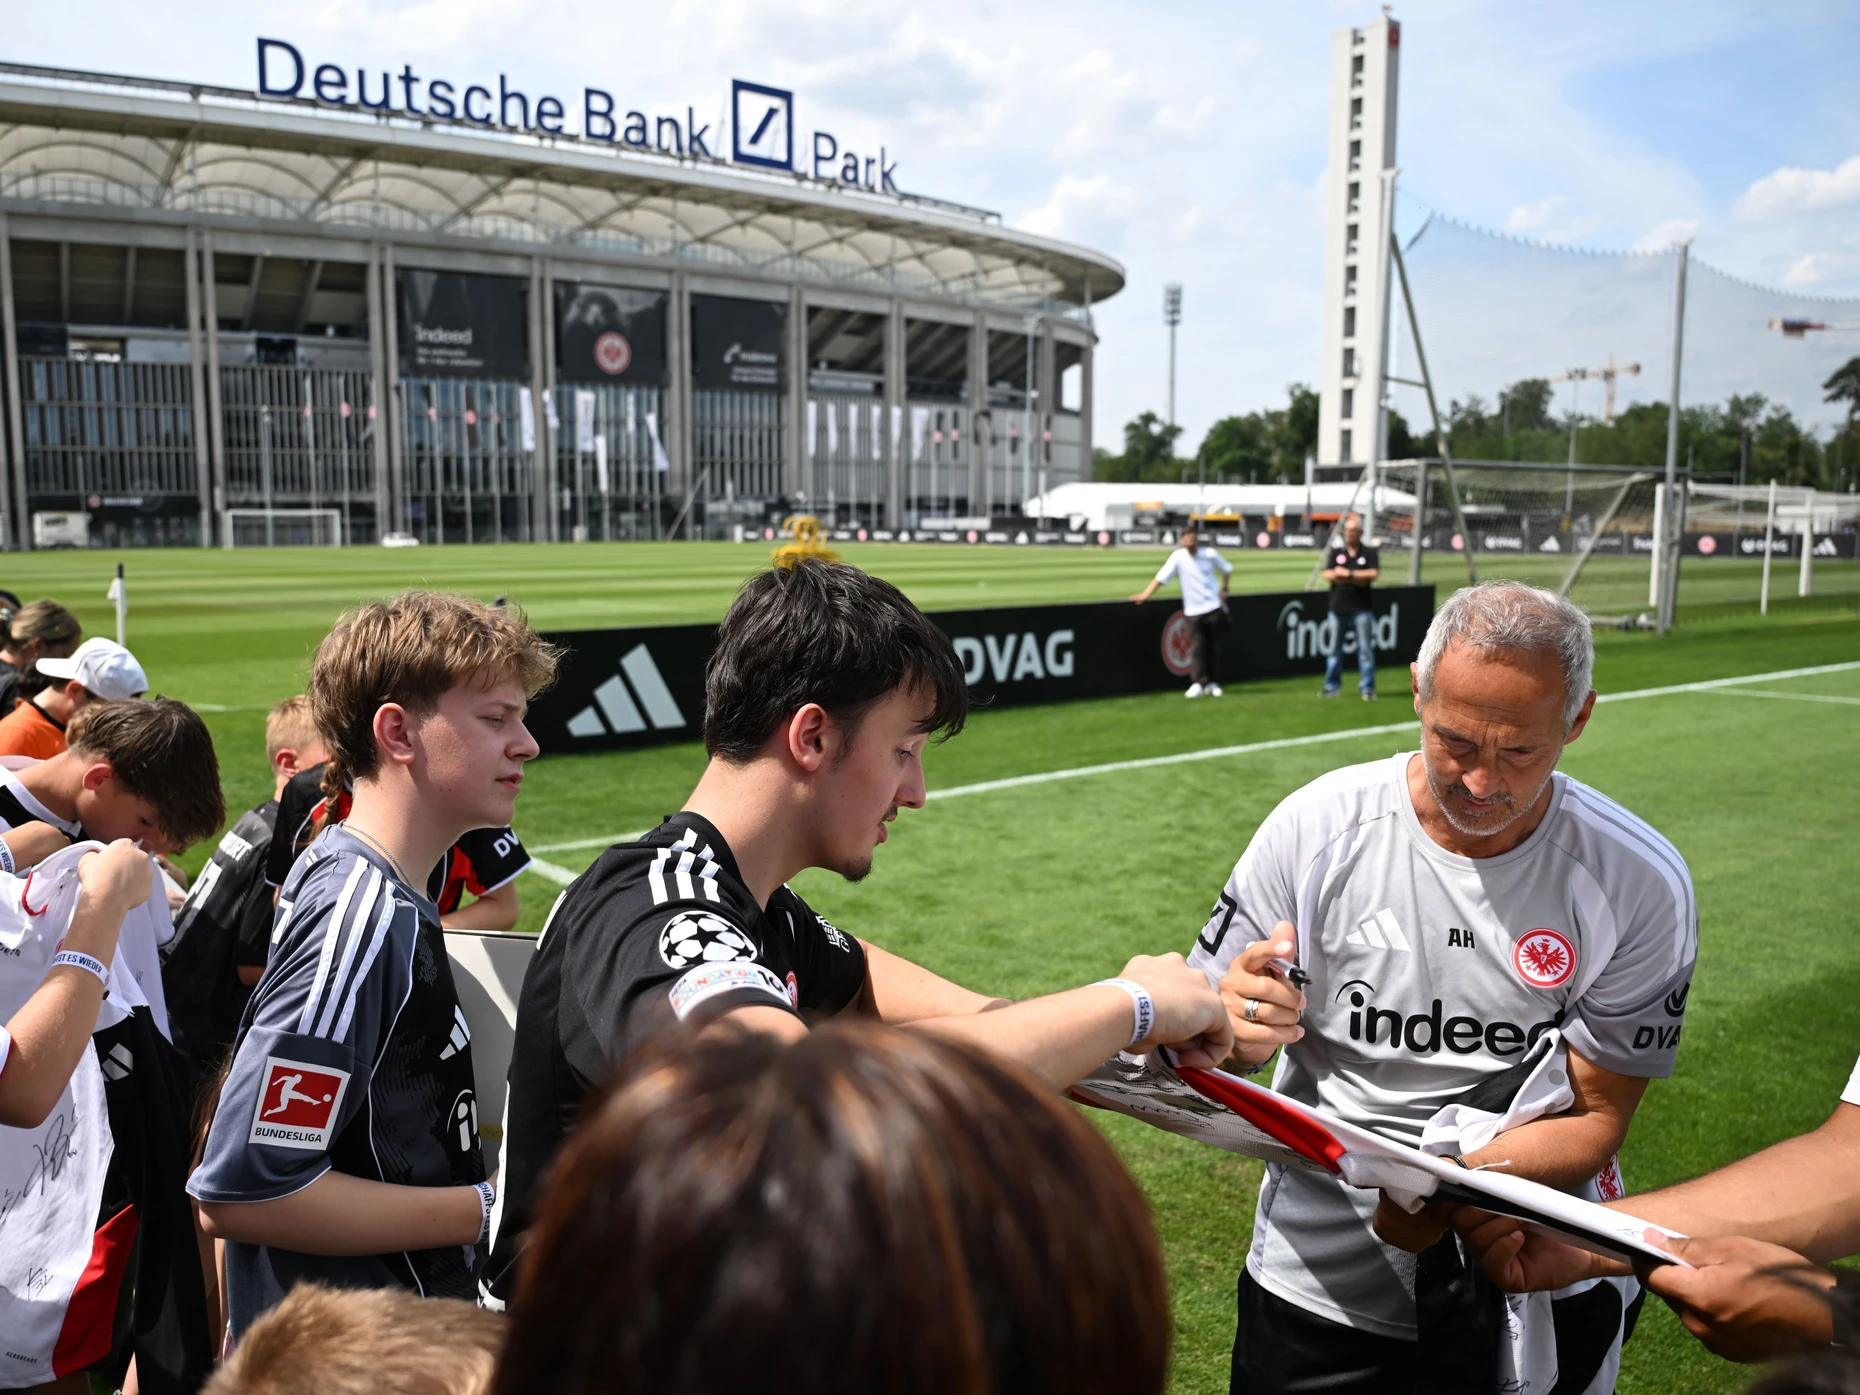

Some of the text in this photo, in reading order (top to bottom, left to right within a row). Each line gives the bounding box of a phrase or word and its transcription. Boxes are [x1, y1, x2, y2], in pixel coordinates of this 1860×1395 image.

[257, 36, 898, 193] Deutsche Bank Park
[1286, 602, 1399, 660] indd
[952, 629, 1075, 687] DVAG
[1448, 928, 1476, 949] AH
[67, 954, 78, 963] ES
[78, 956, 103, 973] WIEDER
[254, 1127, 322, 1143] BUNDESLIGA
